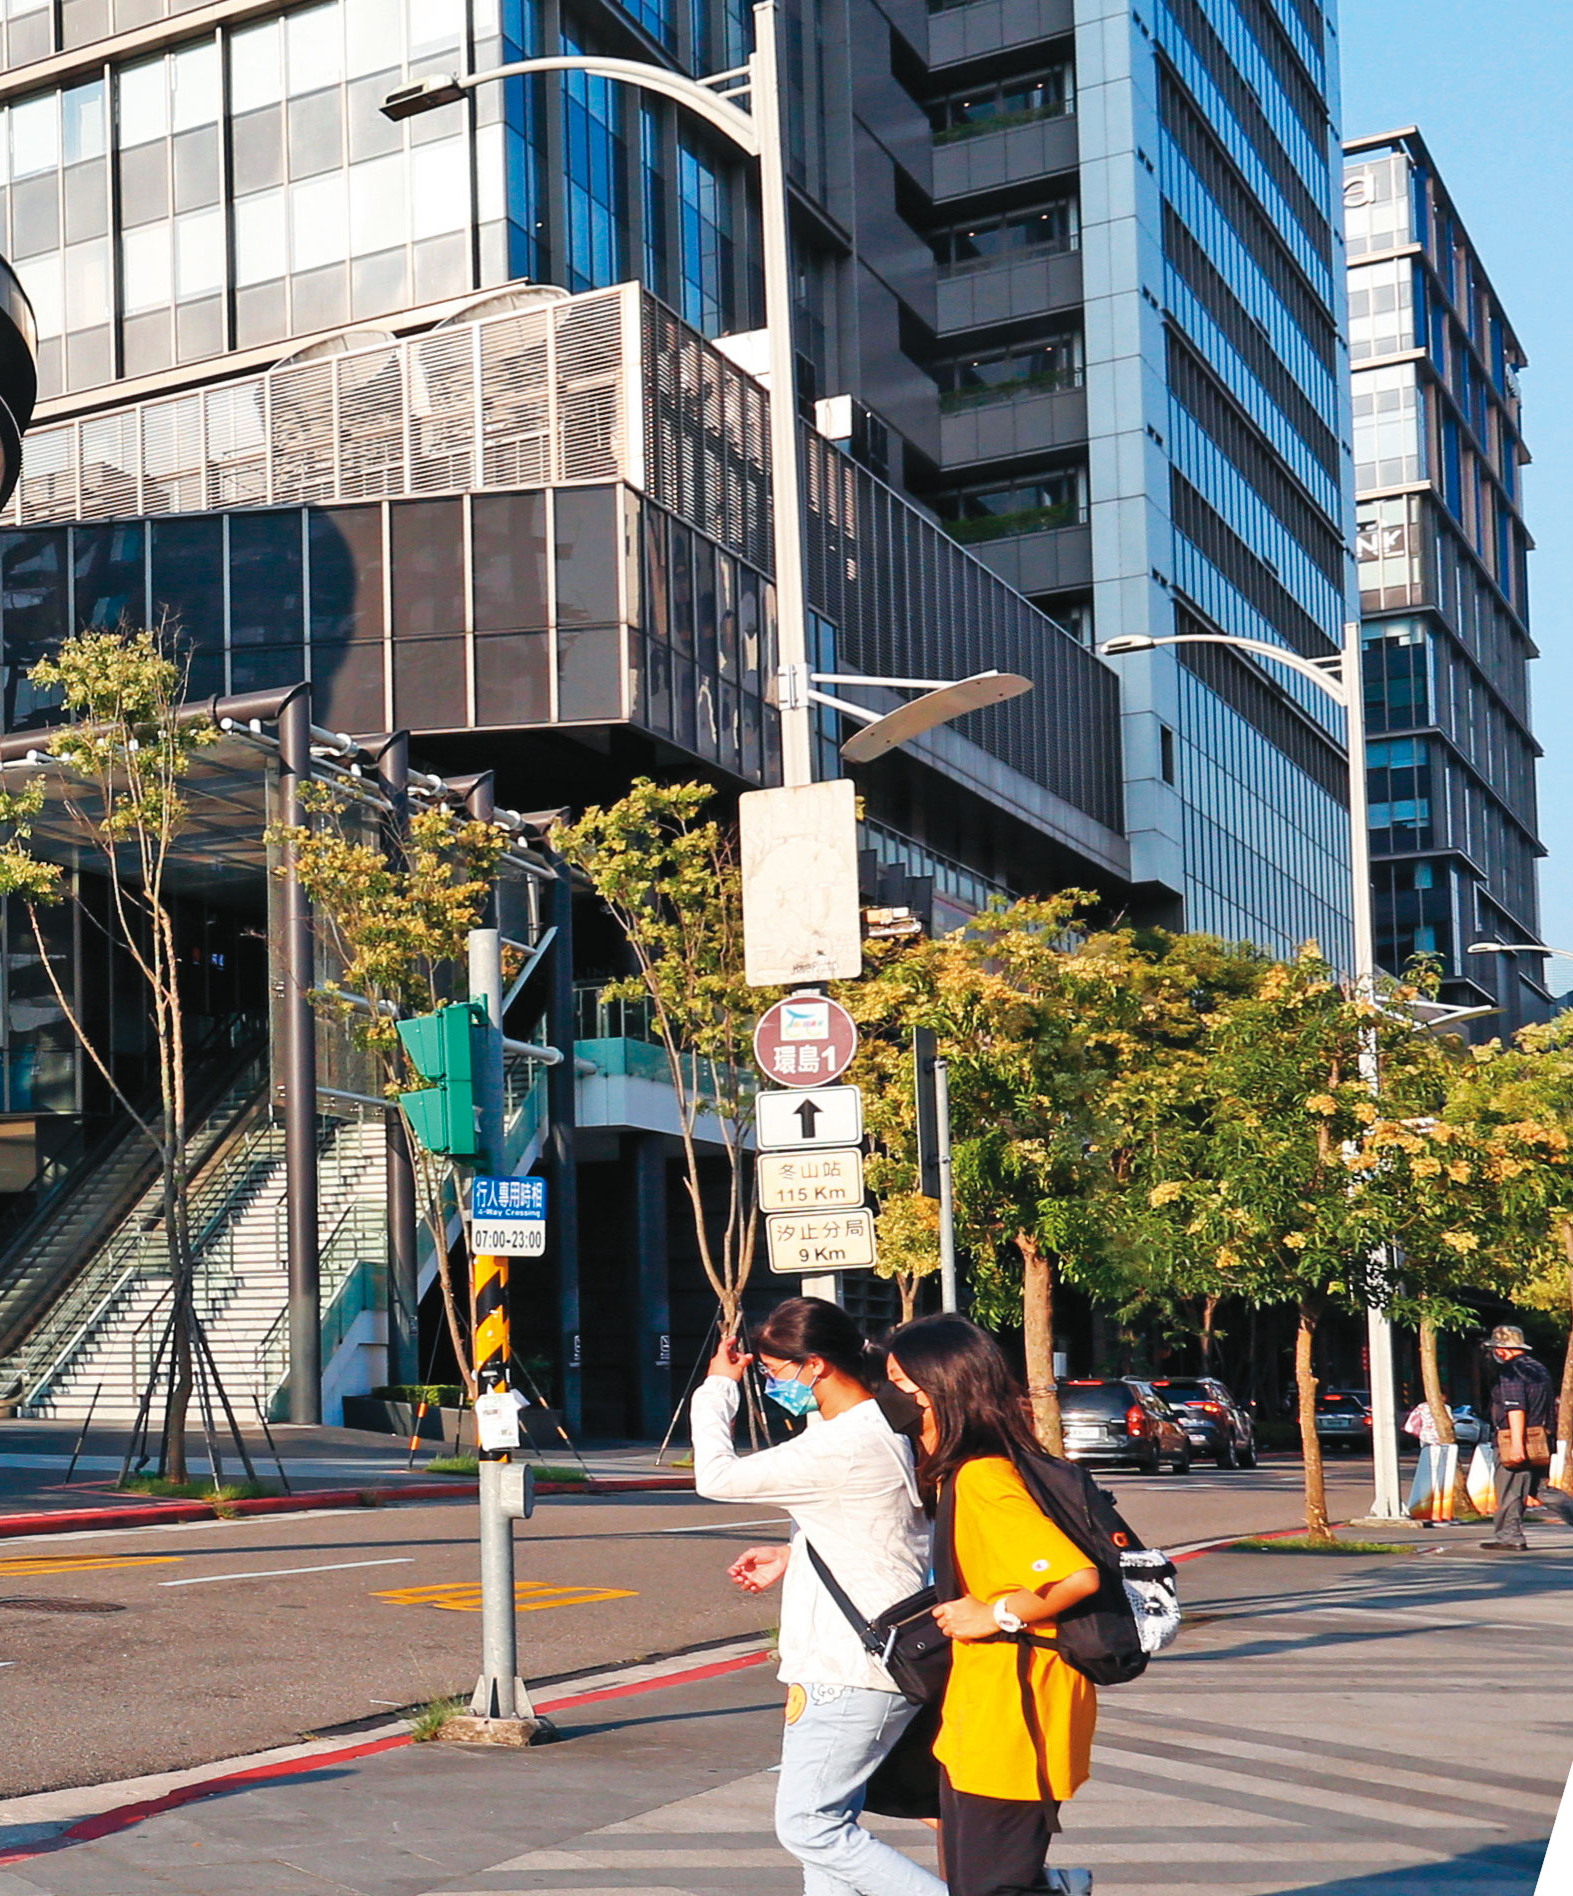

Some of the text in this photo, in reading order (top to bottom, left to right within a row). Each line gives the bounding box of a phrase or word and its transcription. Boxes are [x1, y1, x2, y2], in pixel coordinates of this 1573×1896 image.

[773, 1044, 836, 1074] 環島1
[779, 1160, 842, 1180] 冬山站
[476, 1181, 543, 1208] 行人專用時相
[776, 1186, 846, 1202] 115 Km
[475, 1230, 542, 1249] 07:00-23:00
[777, 1220, 864, 1242] 汐止分局
[798, 1246, 846, 1262] 9 Km
